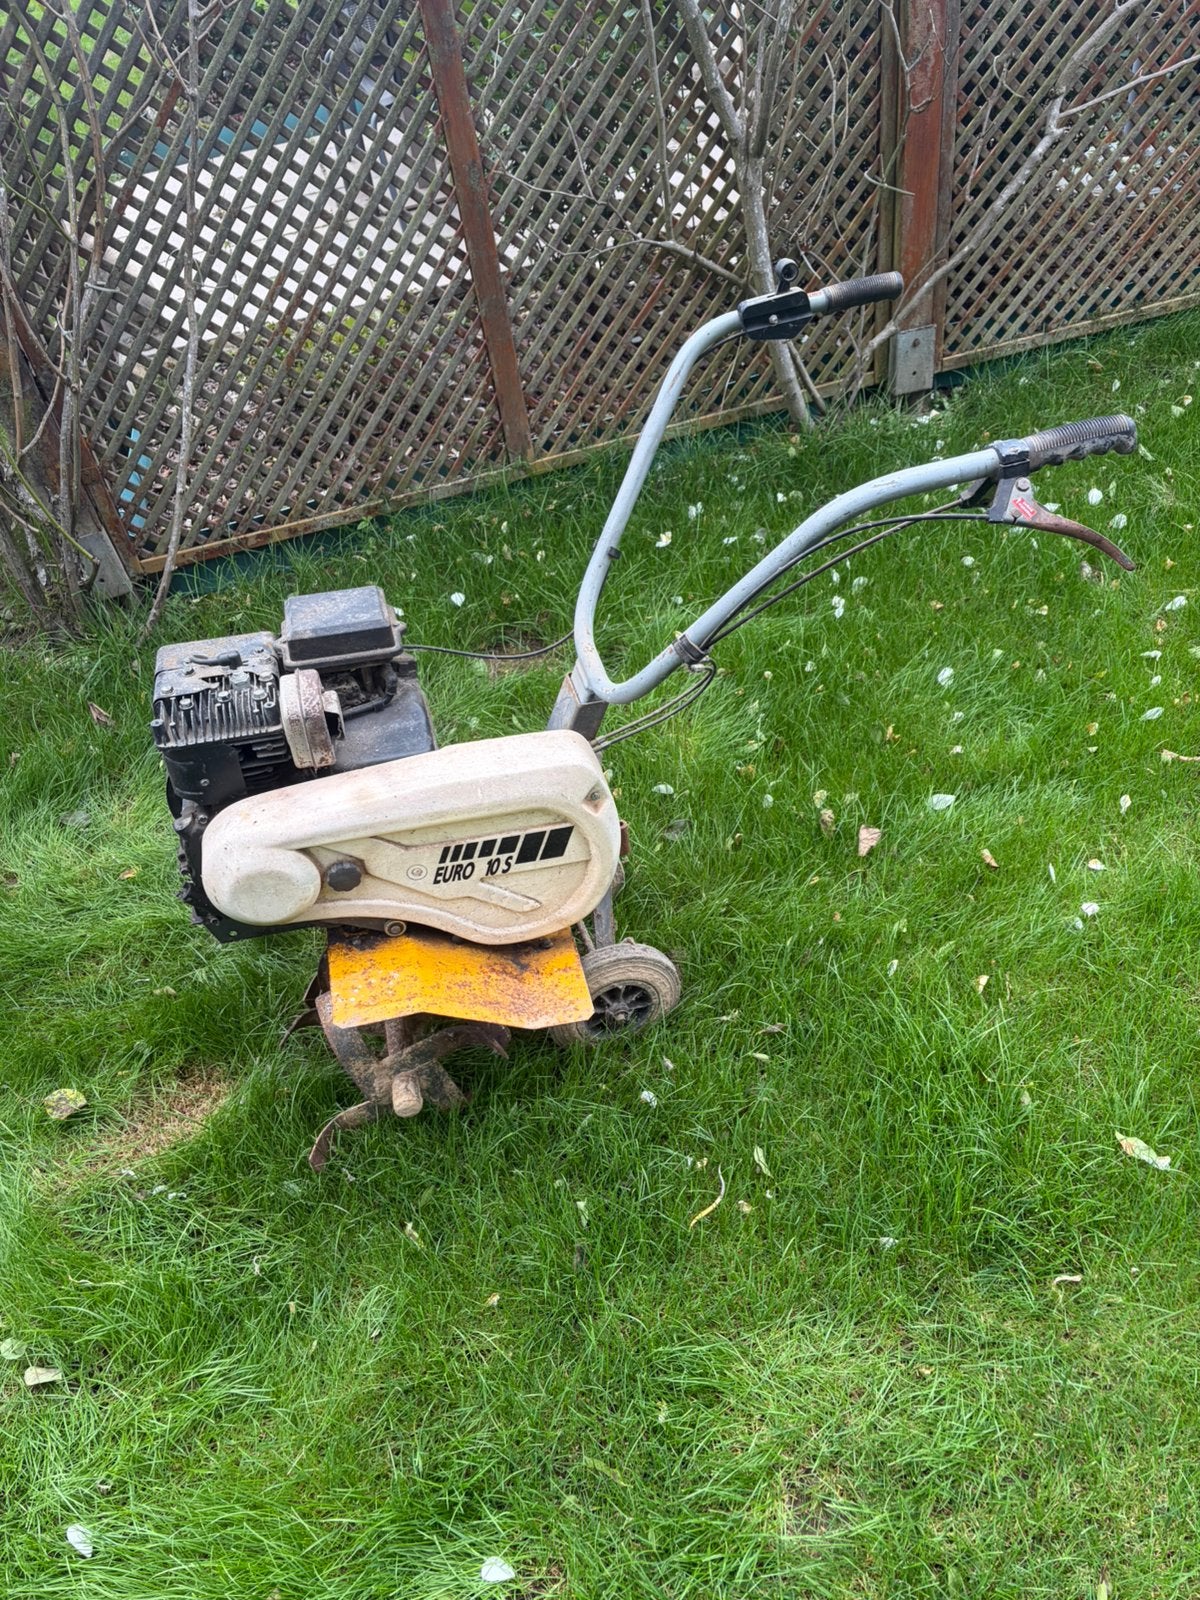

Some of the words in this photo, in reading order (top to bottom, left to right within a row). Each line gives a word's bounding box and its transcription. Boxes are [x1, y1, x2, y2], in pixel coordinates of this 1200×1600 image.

[433, 862, 475, 884] EURO
[485, 857, 500, 876] 10
[501, 855, 513, 874] S
